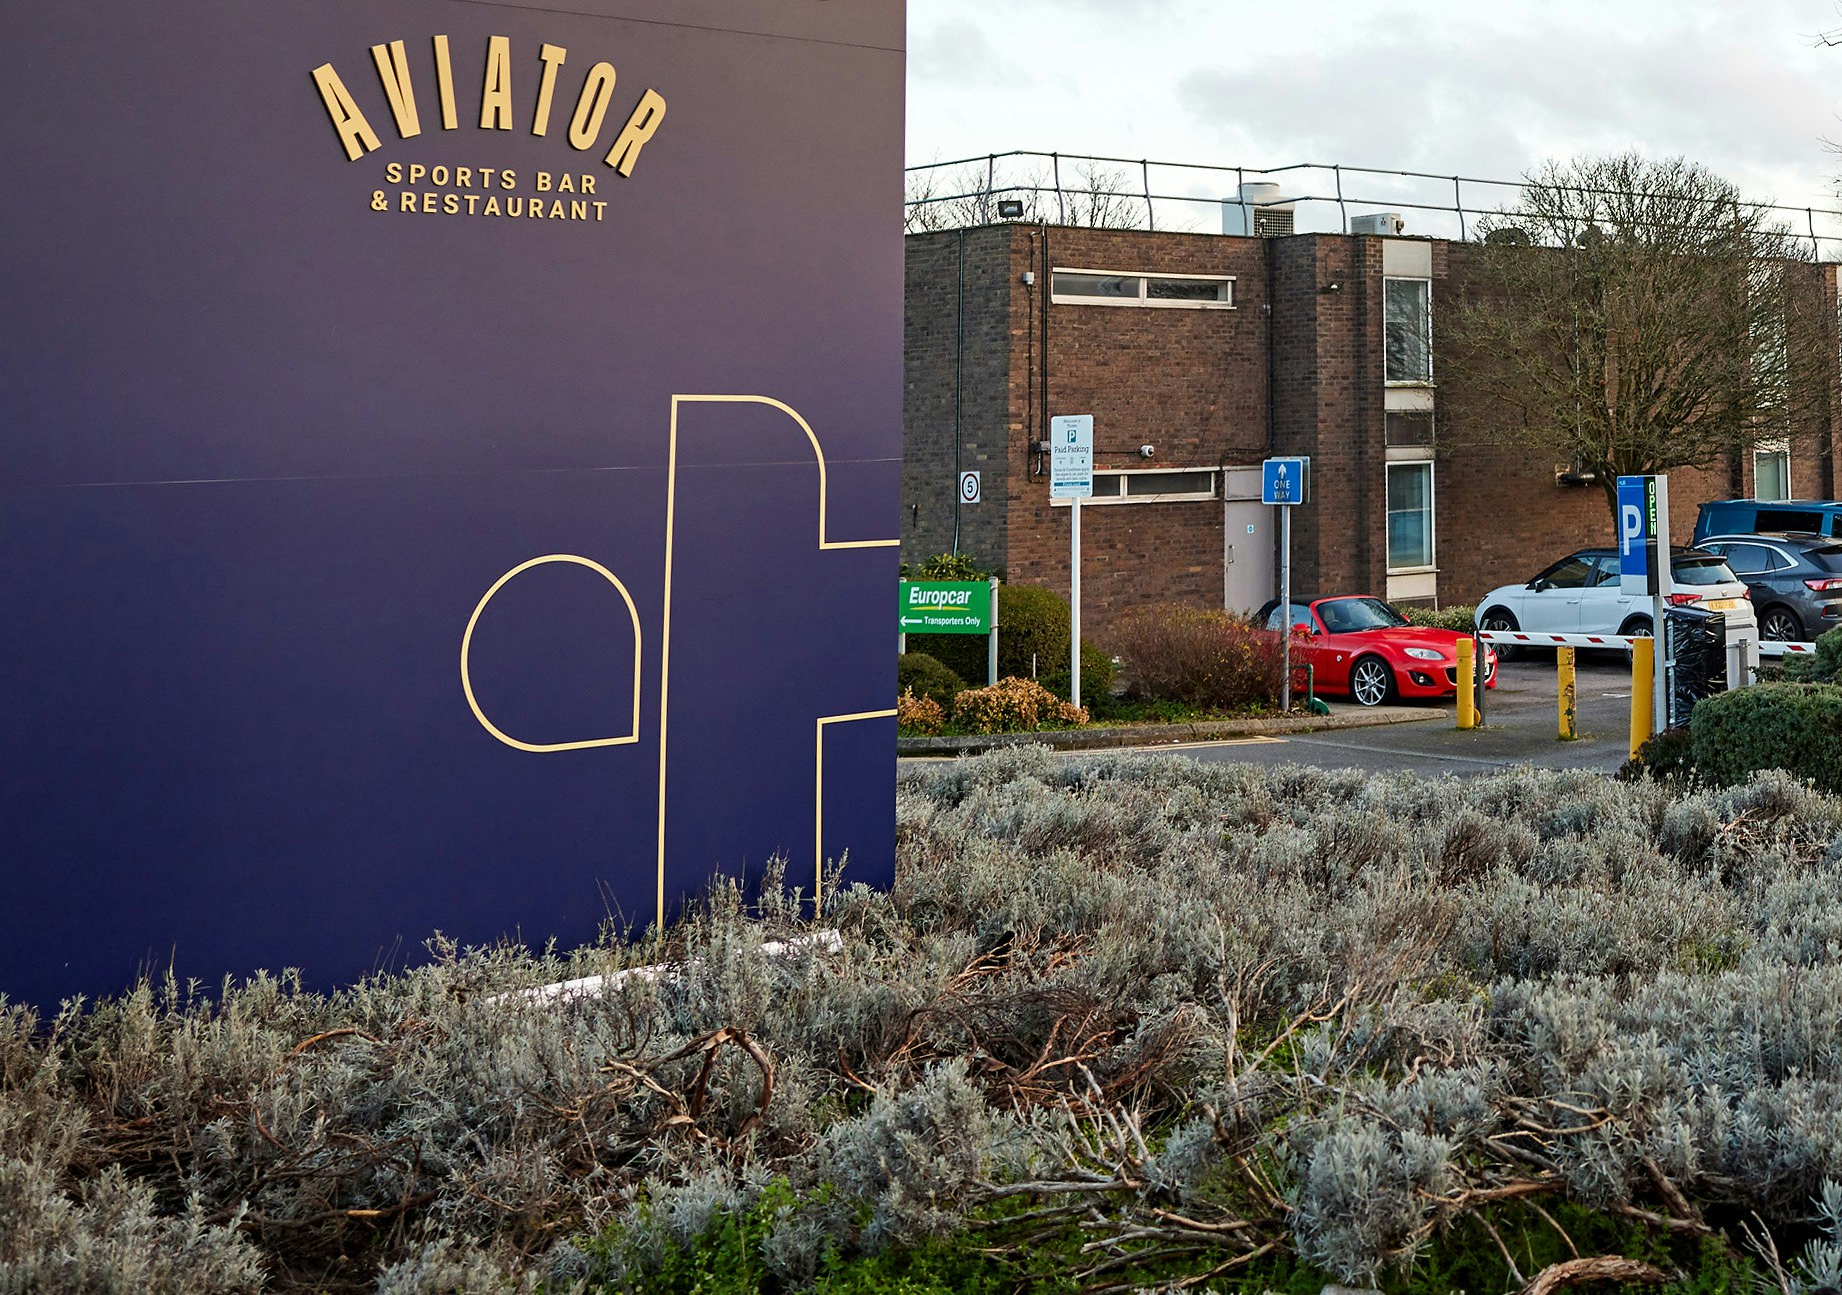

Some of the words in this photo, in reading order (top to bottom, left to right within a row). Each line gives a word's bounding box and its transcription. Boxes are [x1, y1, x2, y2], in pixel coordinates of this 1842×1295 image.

[310, 35, 668, 178] AVIATOR
[386, 162, 517, 190] SPORTS
[536, 171, 597, 194] BAR
[371, 190, 388, 212] &
[400, 191, 608, 221] RESTAURANT
[1054, 446, 1067, 454] Paid
[1067, 445, 1090, 454] Parking
[967, 481, 973, 493] 5
[1273, 480, 1290, 489] ONE
[1273, 490, 1290, 500] WAY
[1649, 481, 1657, 535] OPEN
[1622, 505, 1642, 556] P
[909, 586, 972, 610] Europcar
[924, 616, 964, 626] Transporters
[965, 616, 980, 627] Only
